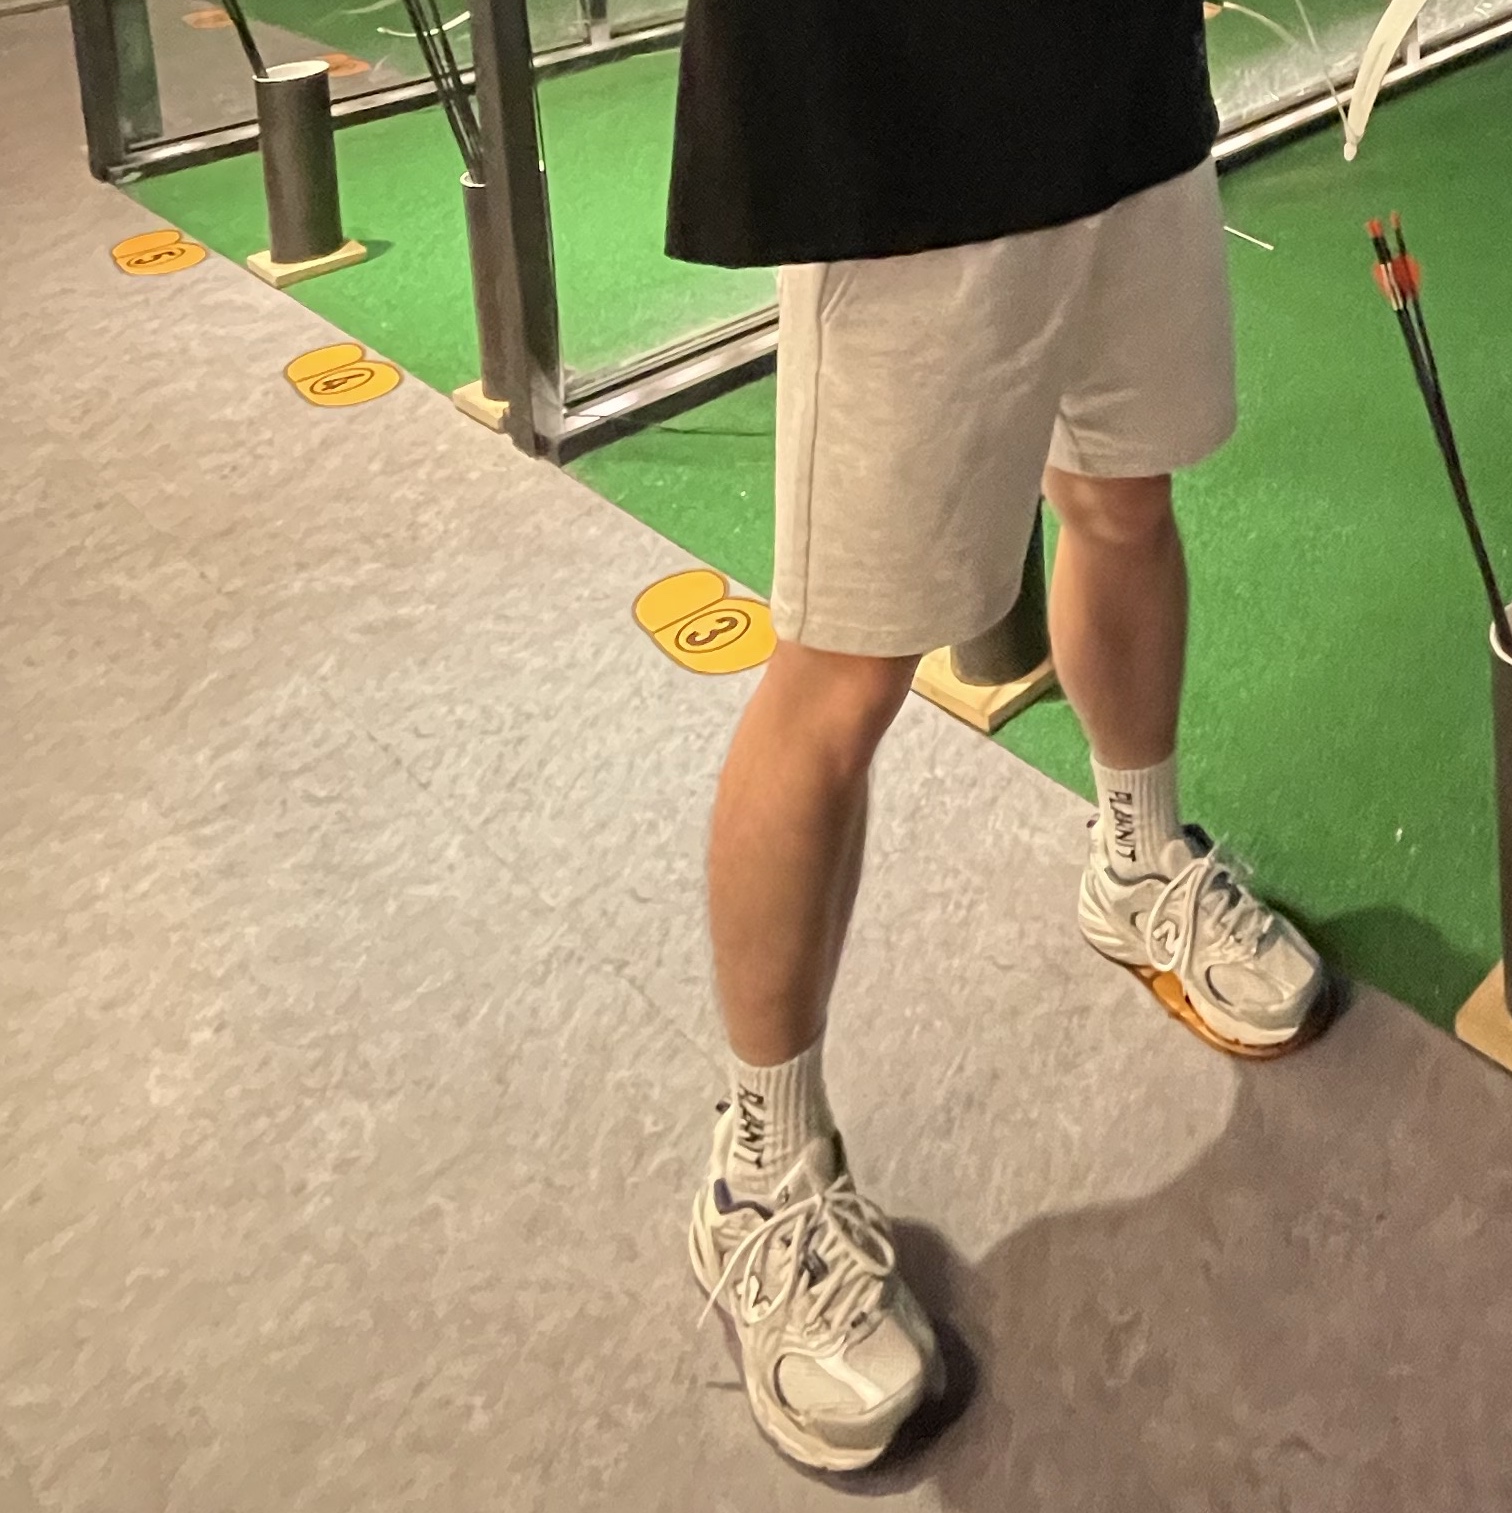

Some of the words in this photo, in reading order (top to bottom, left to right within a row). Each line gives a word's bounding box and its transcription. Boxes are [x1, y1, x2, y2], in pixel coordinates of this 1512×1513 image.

[134, 250, 176, 265] 5
[321, 372, 365, 392] 4
[685, 616, 739, 647] 3
